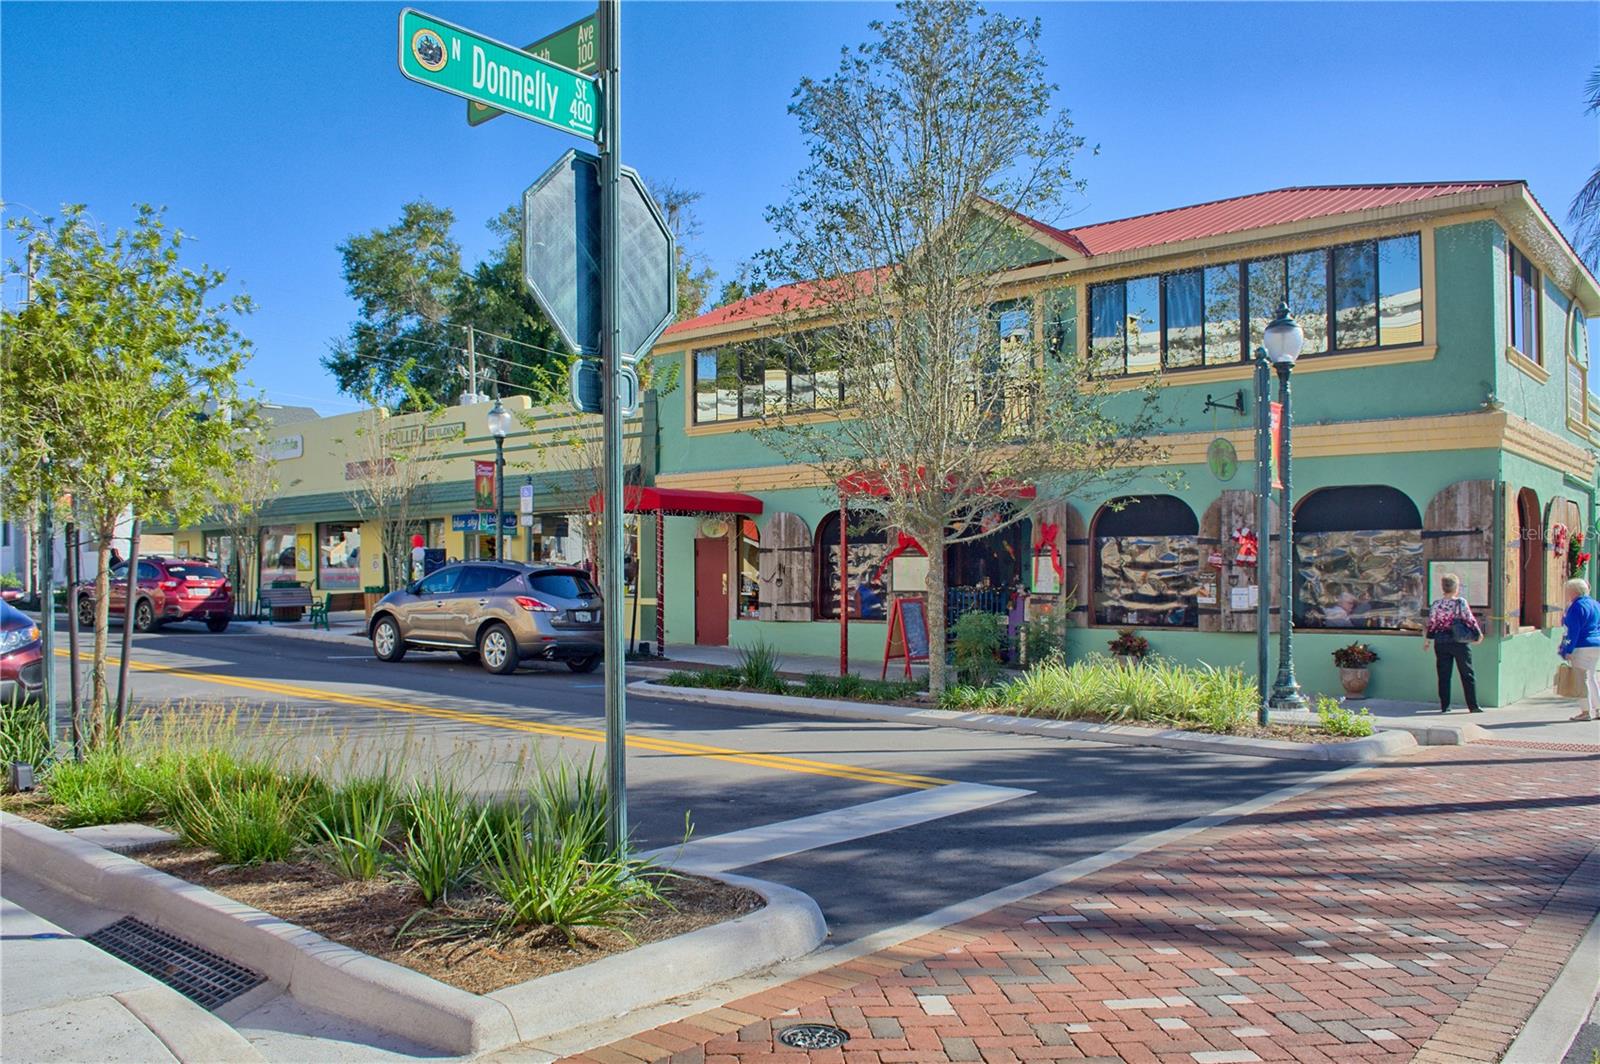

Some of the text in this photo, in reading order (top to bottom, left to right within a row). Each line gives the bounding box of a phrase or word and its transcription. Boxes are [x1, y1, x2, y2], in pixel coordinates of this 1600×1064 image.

[578, 24, 594, 45] Ave
[578, 41, 593, 65] 100
[452, 37, 559, 120] N Donnelly
[575, 78, 587, 101] St
[569, 98, 592, 124] 400
